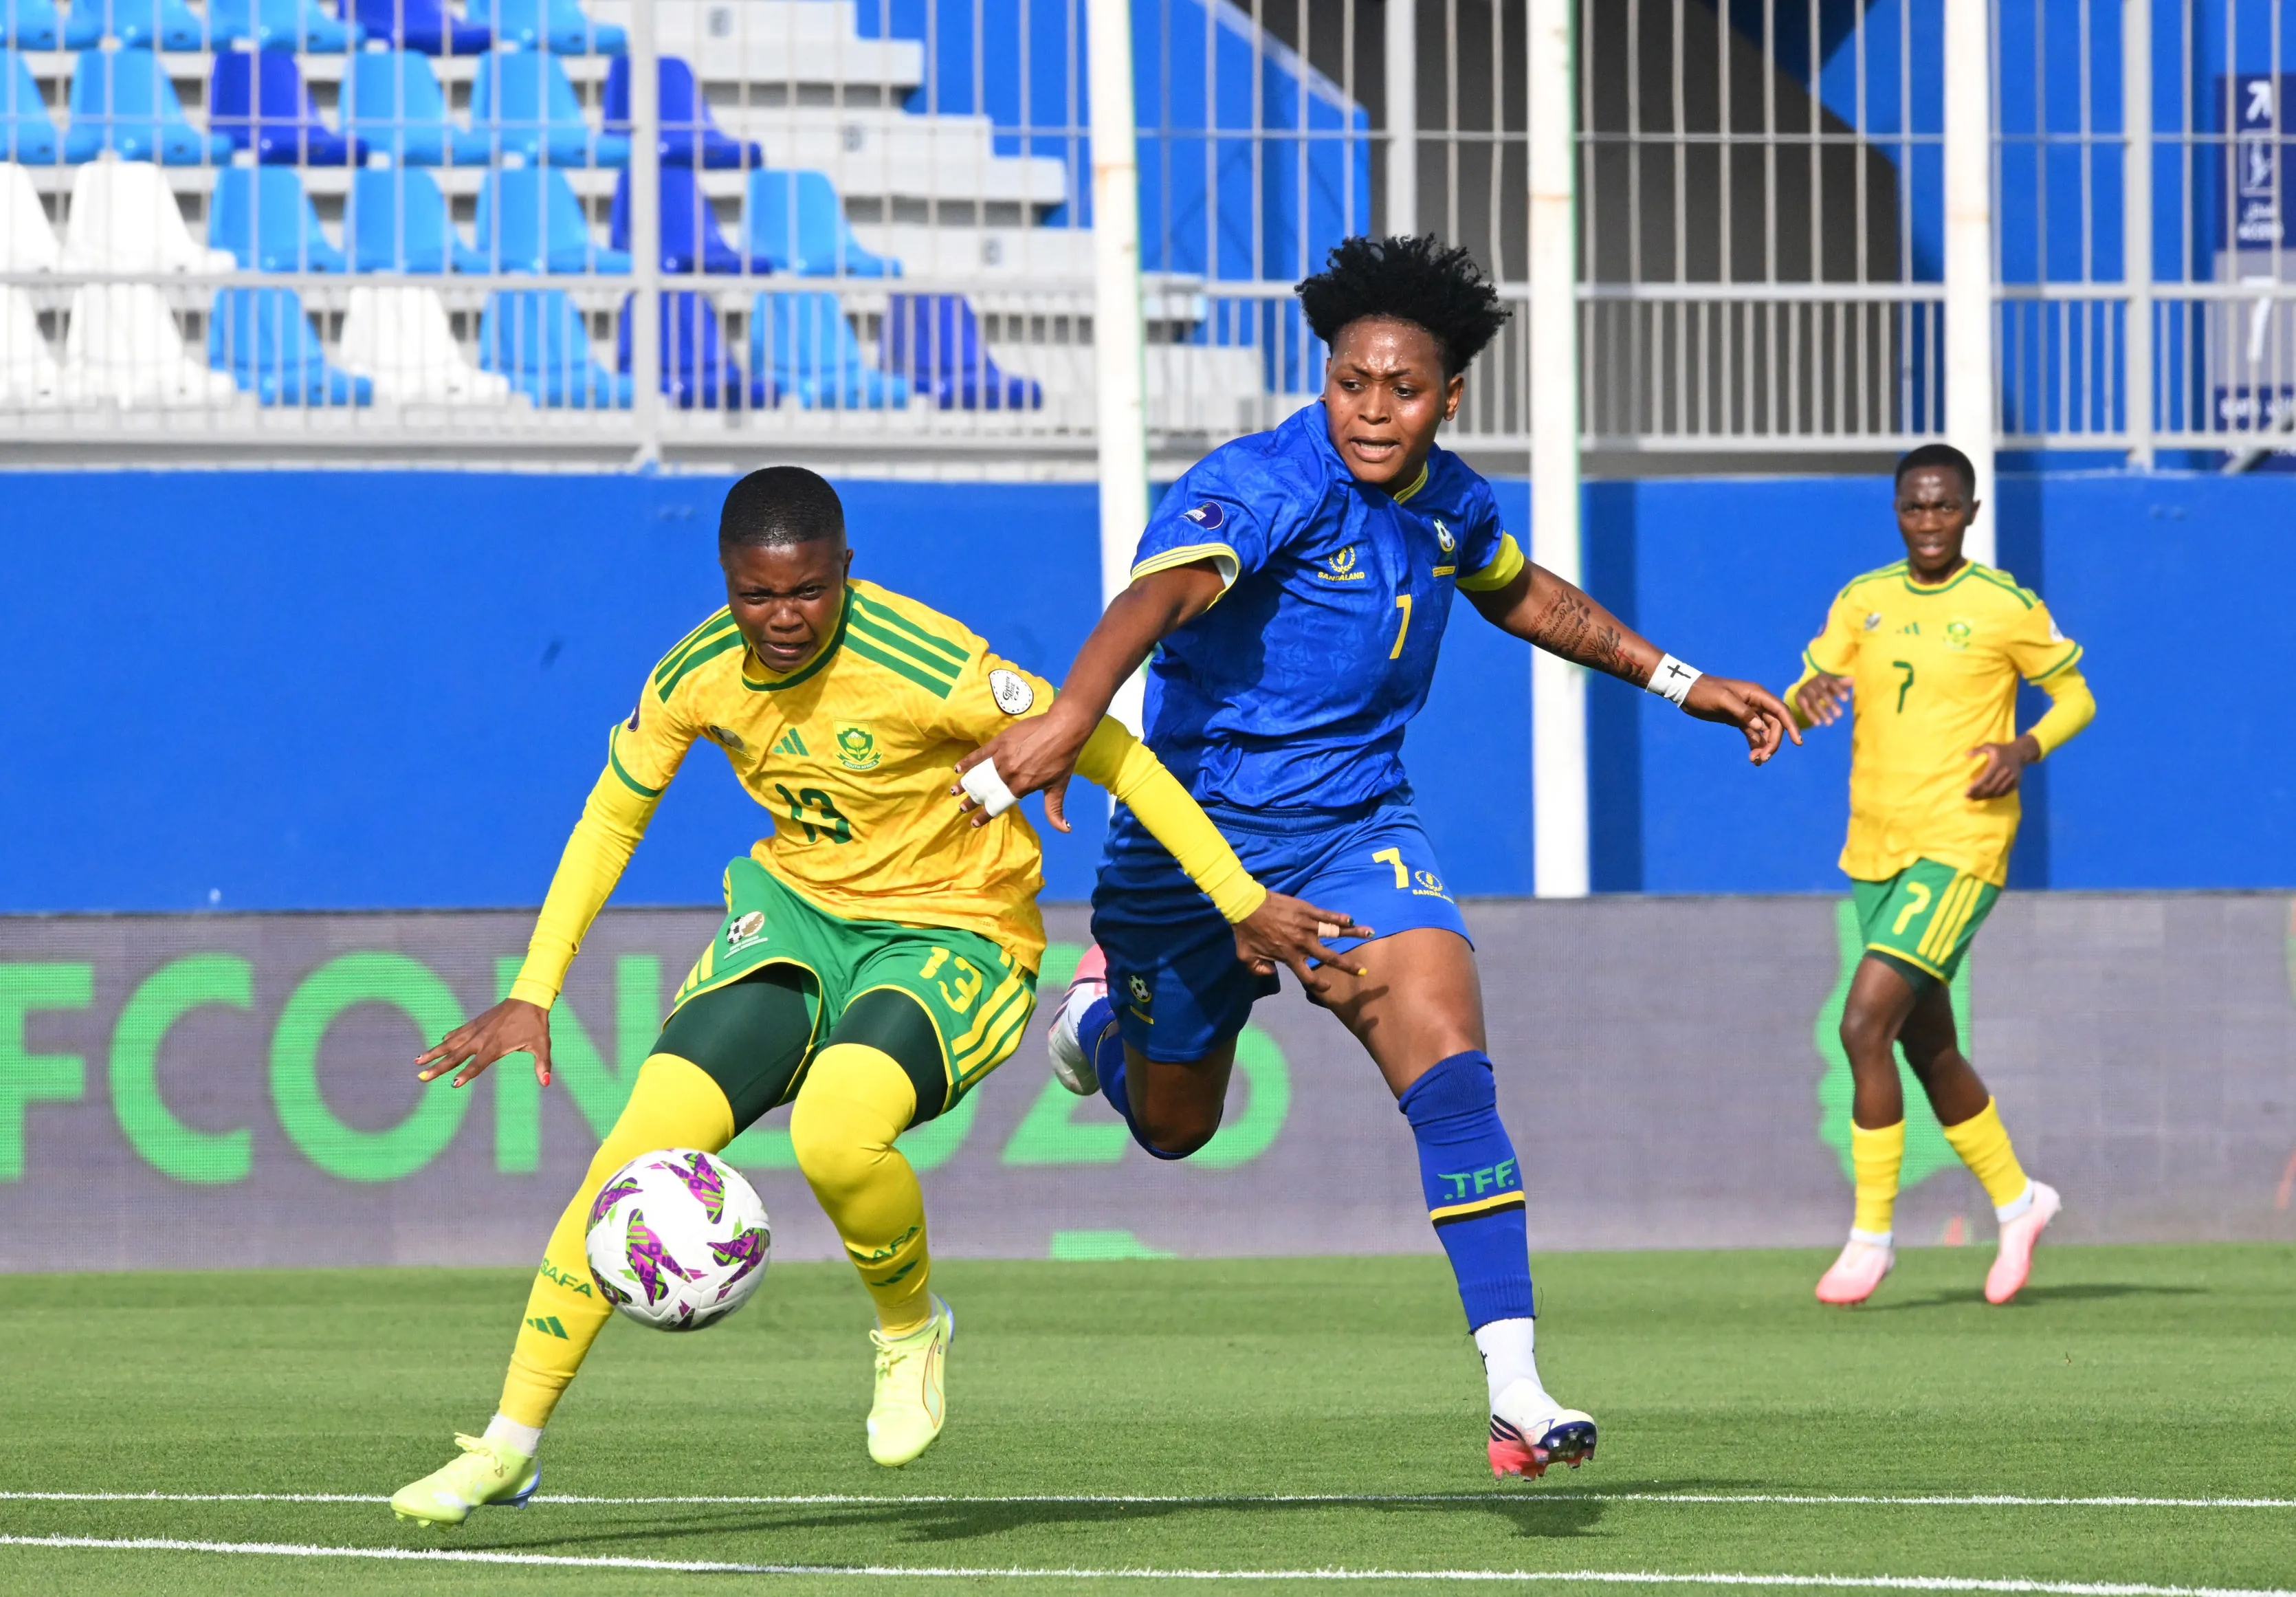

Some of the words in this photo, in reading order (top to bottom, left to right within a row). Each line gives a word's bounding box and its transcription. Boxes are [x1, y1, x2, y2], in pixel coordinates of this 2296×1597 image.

[1389, 594, 1412, 659] 7
[1892, 661, 1914, 714] 7
[775, 783, 853, 844] 13
[1371, 847, 1409, 889] 7
[1892, 881, 1932, 935] 7
[918, 946, 982, 1014] 13
[540, 1257, 592, 1298] SAFA
